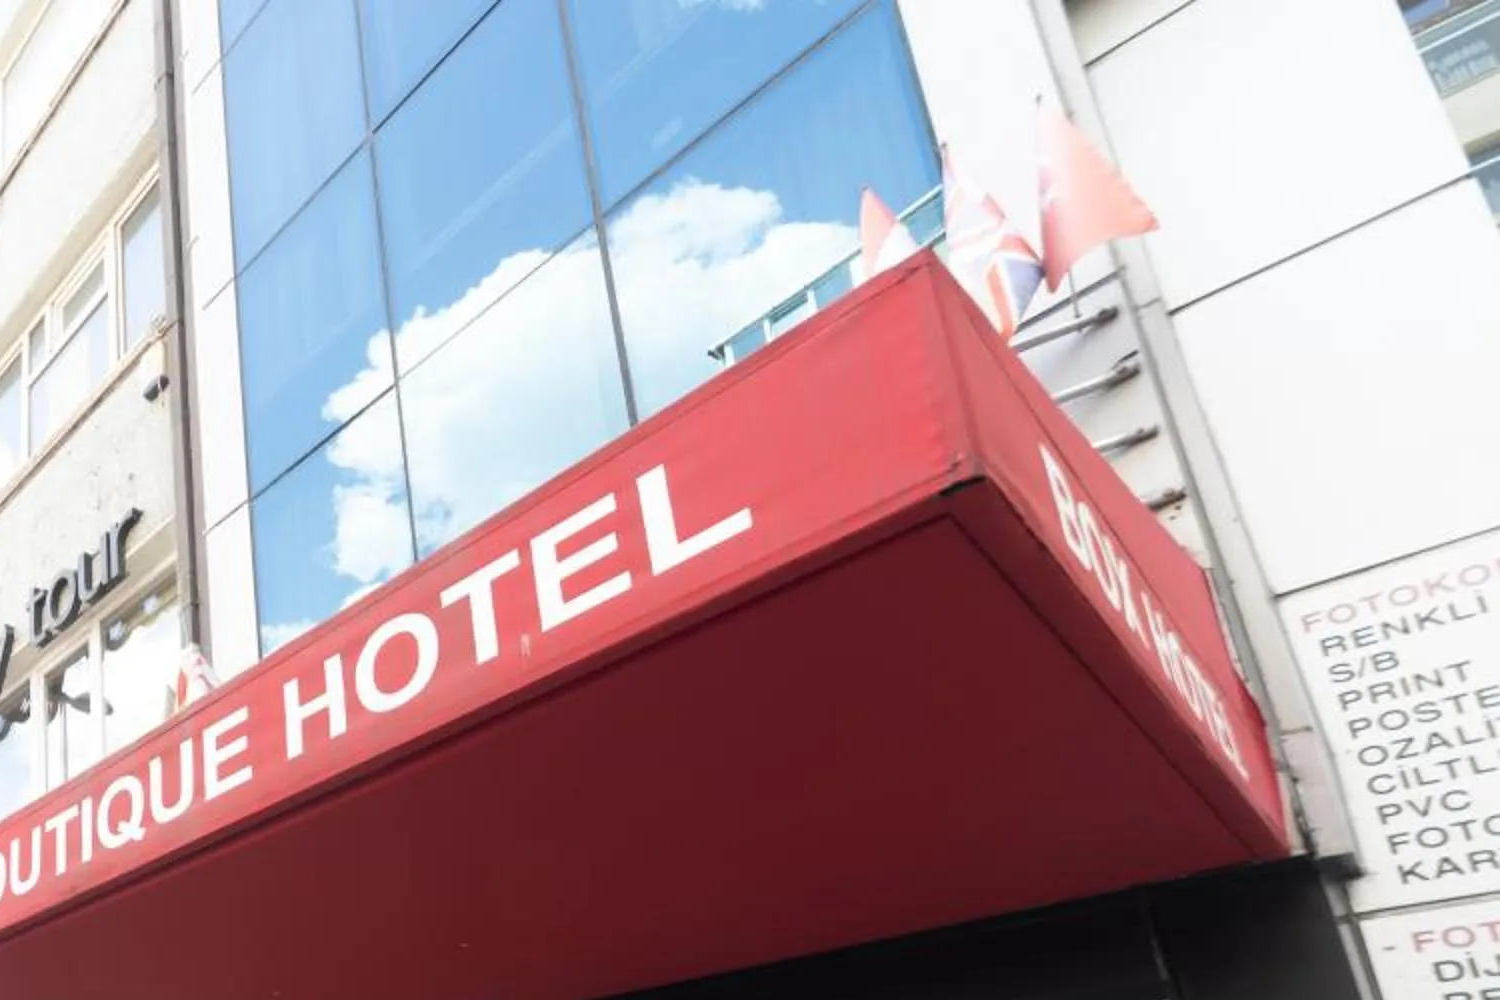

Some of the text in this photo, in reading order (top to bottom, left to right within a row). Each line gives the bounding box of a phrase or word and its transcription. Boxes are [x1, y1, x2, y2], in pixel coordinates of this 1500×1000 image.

[27, 508, 144, 650] tour
[283, 463, 754, 760] HOTEL
[1039, 443, 1250, 781] BOX HOTEL
[1301, 557, 1500, 634] FOTOKO
[1328, 651, 1400, 683] S/B
[1338, 660, 1471, 712] PRINT
[1376, 789, 1472, 825] PVC
